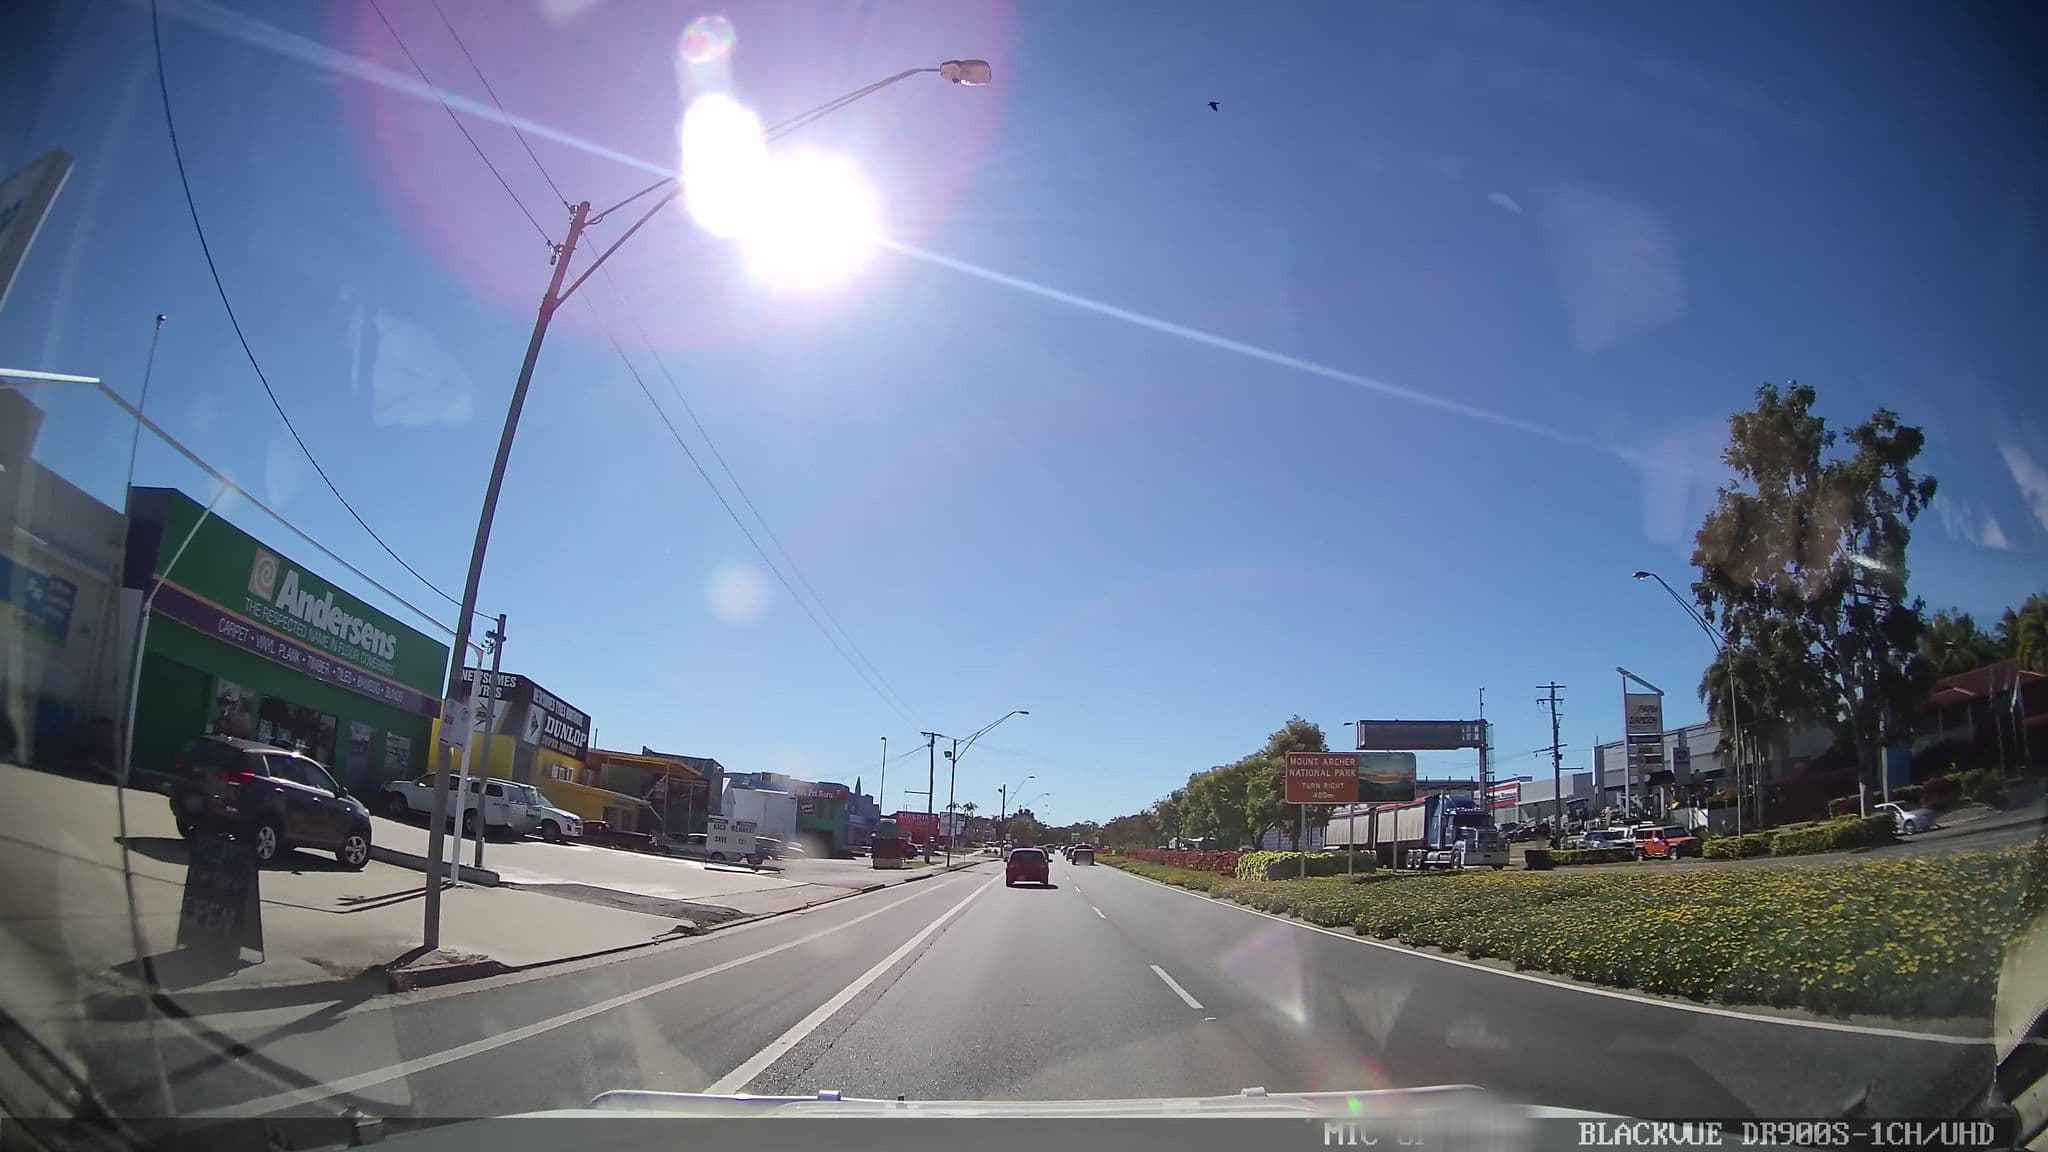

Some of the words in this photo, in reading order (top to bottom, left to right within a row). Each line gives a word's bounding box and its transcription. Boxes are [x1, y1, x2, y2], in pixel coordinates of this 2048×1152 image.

[275, 569, 397, 660] Andersens
[218, 617, 250, 643] CARPET
[279, 643, 302, 665] PLANK
[246, 597, 261, 617] THE
[262, 606, 307, 638] RESPECTED
[307, 628, 330, 649] NAME
[338, 642, 360, 662] FLOOR
[462, 669, 517, 688] NESMES
[544, 715, 588, 748] DUNLOP
[1289, 768, 1332, 777] NATIONAL
[1334, 768, 1356, 777] PARK
[1290, 757, 1319, 766] MOUNT
[1322, 758, 1356, 766] ARCHER
[1301, 782, 1321, 790] TURN
[1323, 782, 1345, 790] RIGHT
